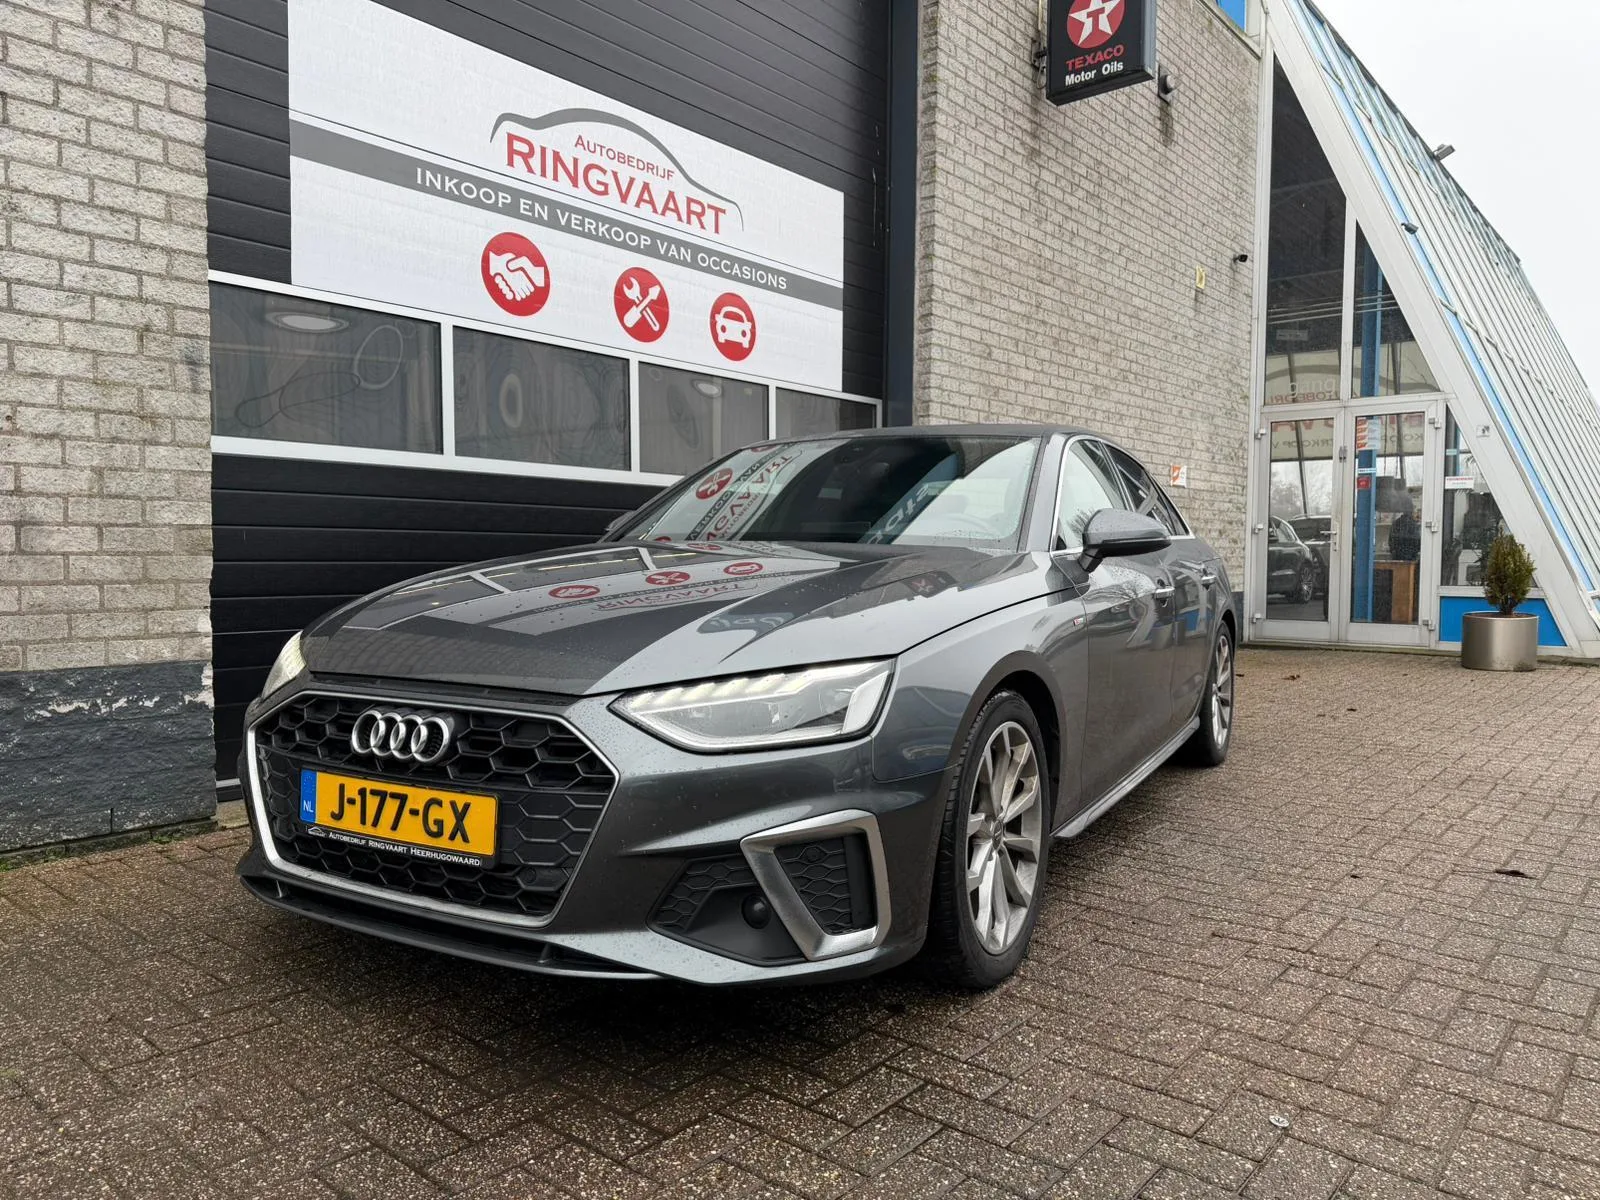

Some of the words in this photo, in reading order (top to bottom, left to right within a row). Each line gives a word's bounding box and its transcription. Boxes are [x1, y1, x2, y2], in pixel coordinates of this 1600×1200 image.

[1065, 44, 1125, 72] TEXACO
[1065, 69, 1097, 87] Motor
[1102, 61, 1124, 75] Oils
[574, 134, 675, 182] AUTOBEDRIJF
[506, 131, 727, 235] RINGVAART
[416, 167, 513, 209] INKOOP
[519, 200, 549, 221] EN
[556, 208, 652, 250] VERKOOP
[656, 239, 692, 263] VAN
[697, 245, 788, 290] OCCASIONS
[303, 800, 314, 813] NL
[330, 783, 472, 844] J-177-GX
[328, 831, 368, 846] AUTOBEDRIJF
[368, 839, 408, 855] RINGVAART
[410, 847, 481, 866] HEERHUGOWAARD
